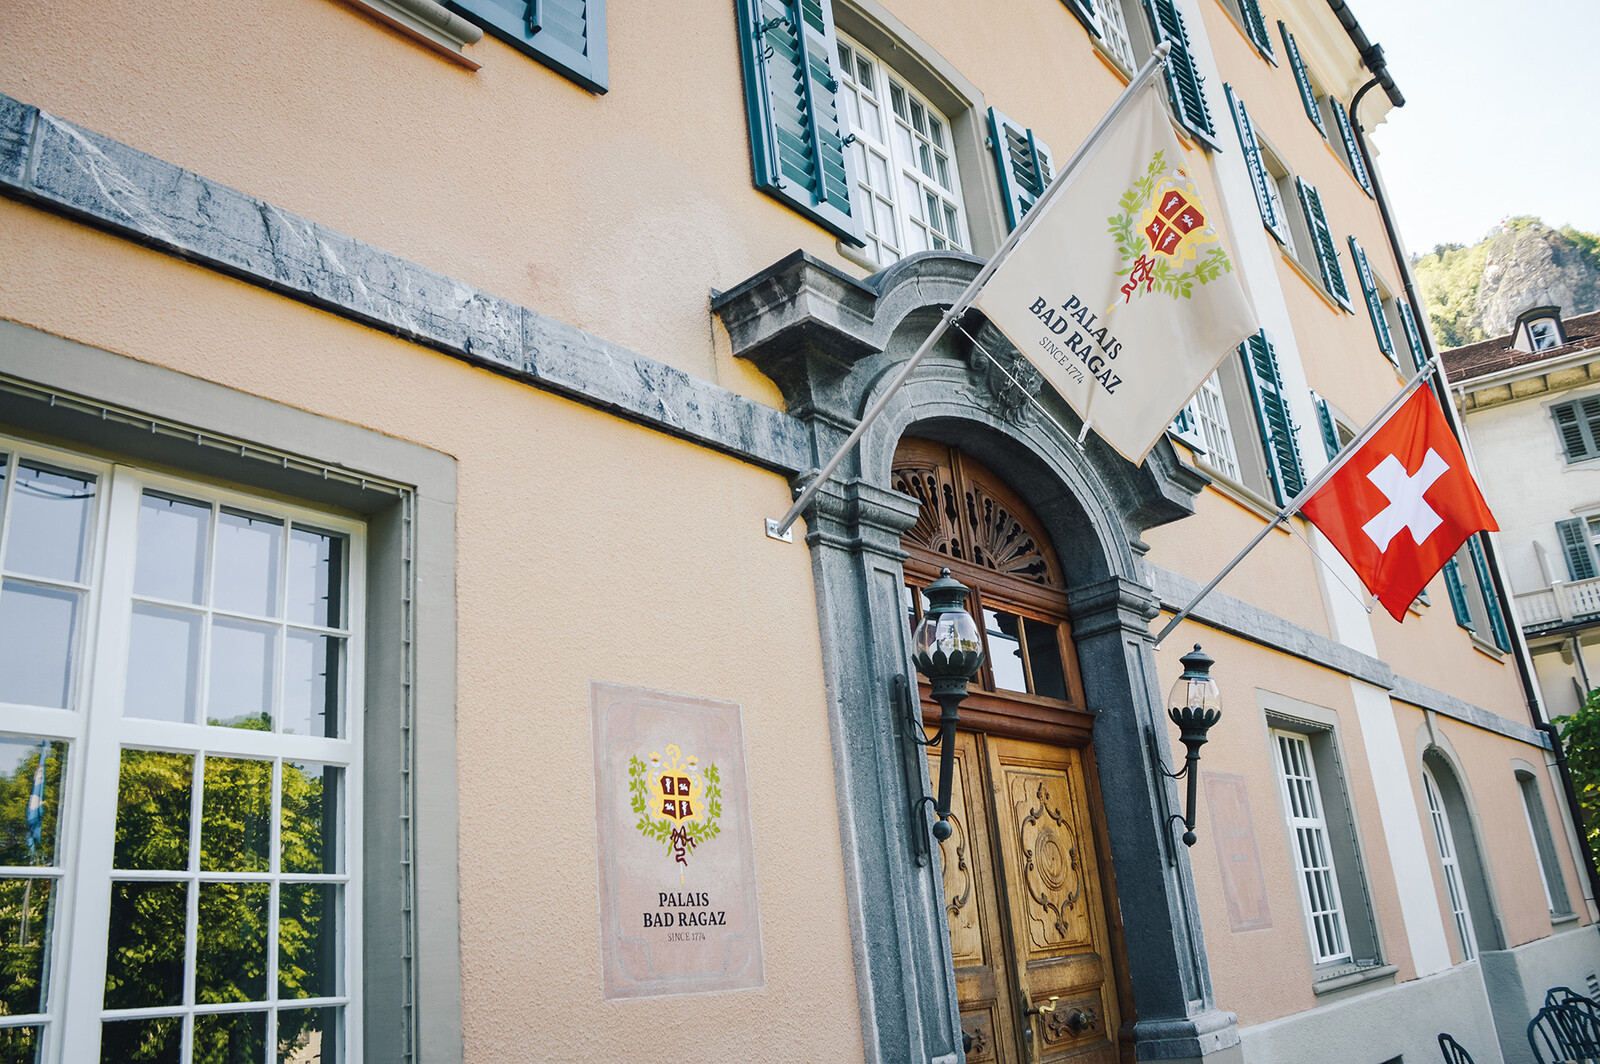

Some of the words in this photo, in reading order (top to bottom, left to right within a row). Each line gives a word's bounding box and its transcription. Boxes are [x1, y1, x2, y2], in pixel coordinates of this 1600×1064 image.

[1061, 294, 1123, 360] PALAIS
[1028, 296, 1069, 335] BAD
[1063, 331, 1123, 395] RAGAZ
[1038, 336, 1069, 366] SINCE
[1065, 363, 1085, 385] 1774
[658, 892, 710, 907] PALAIS
[642, 912, 674, 928] BAD
[677, 911, 727, 927] RAGAZ
[667, 932, 691, 942] SINCE
[691, 932, 706, 941] 1774
